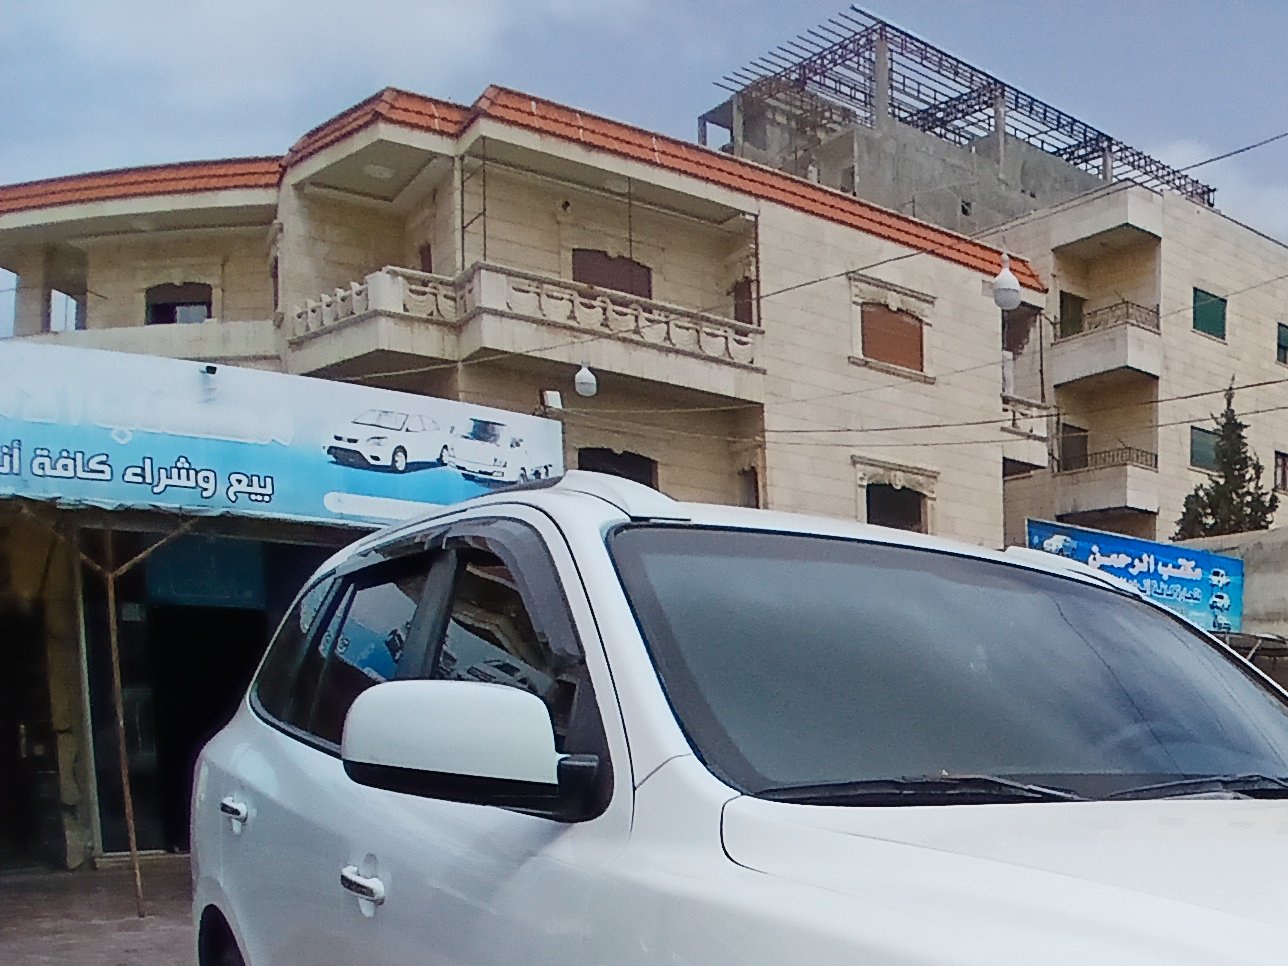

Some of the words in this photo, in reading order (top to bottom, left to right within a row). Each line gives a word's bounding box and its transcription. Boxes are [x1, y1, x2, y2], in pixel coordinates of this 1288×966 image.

[31, 447, 113, 481] كافة
[123, 456, 217, 499] وشراء
[227, 472, 274, 503] بيع
